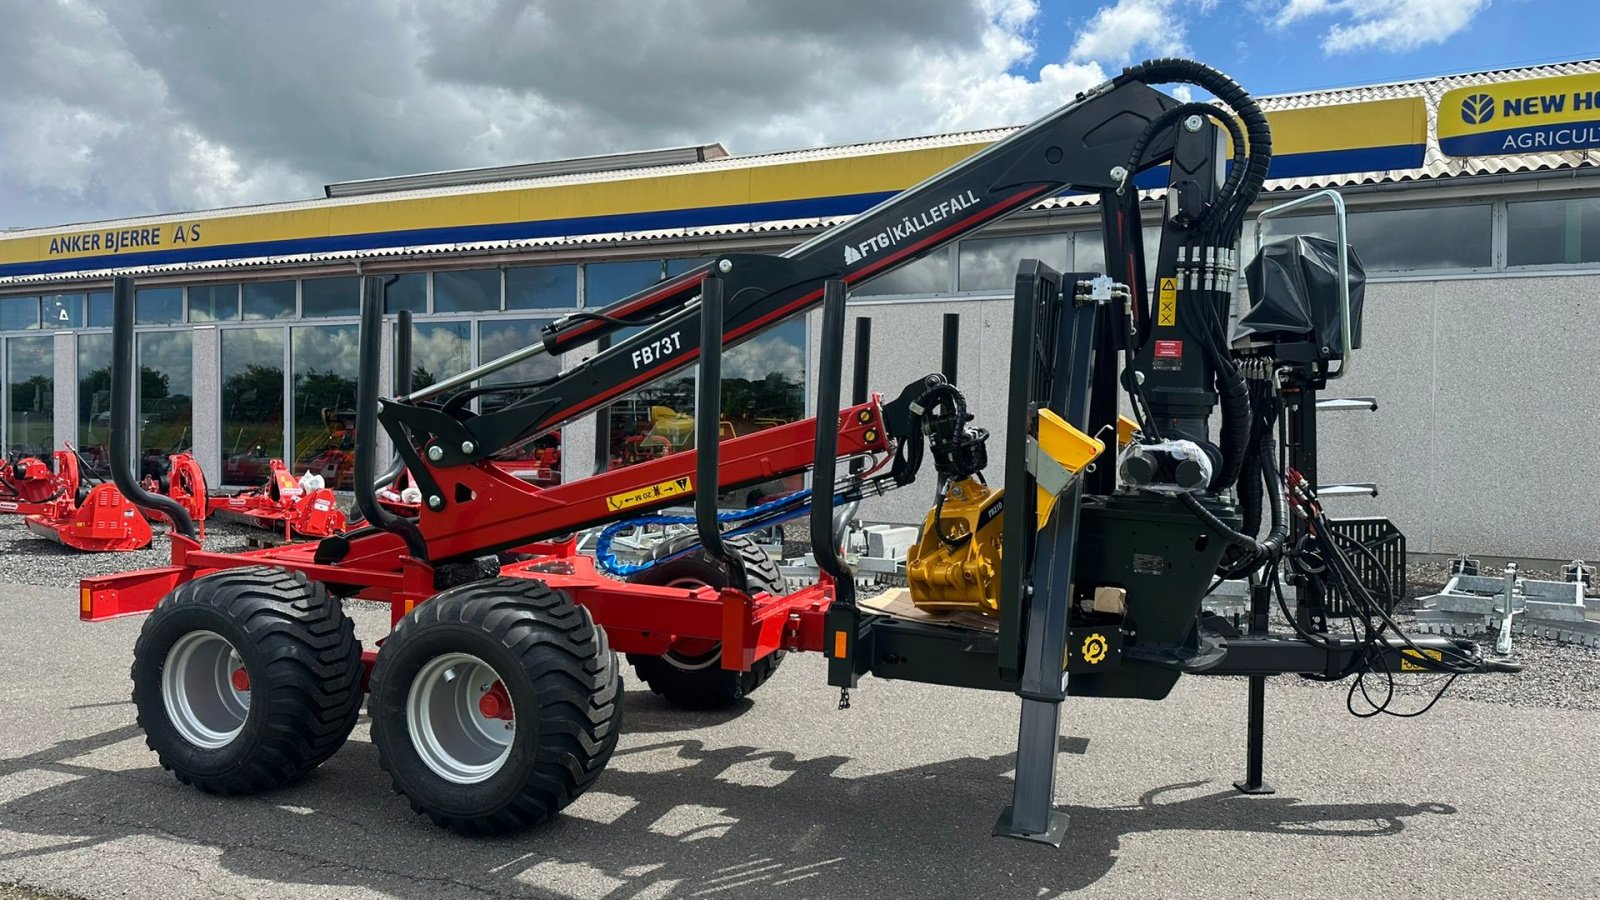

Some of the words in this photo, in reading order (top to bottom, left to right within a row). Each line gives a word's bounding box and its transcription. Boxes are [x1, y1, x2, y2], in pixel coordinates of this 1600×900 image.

[1503, 94, 1566, 117] NEW
[1502, 127, 1600, 149] AGRICUL
[49, 234, 100, 254] ANKER
[105, 228, 160, 252] BJERRE
[173, 223, 201, 244] A/S
[631, 331, 682, 370] FB73T
